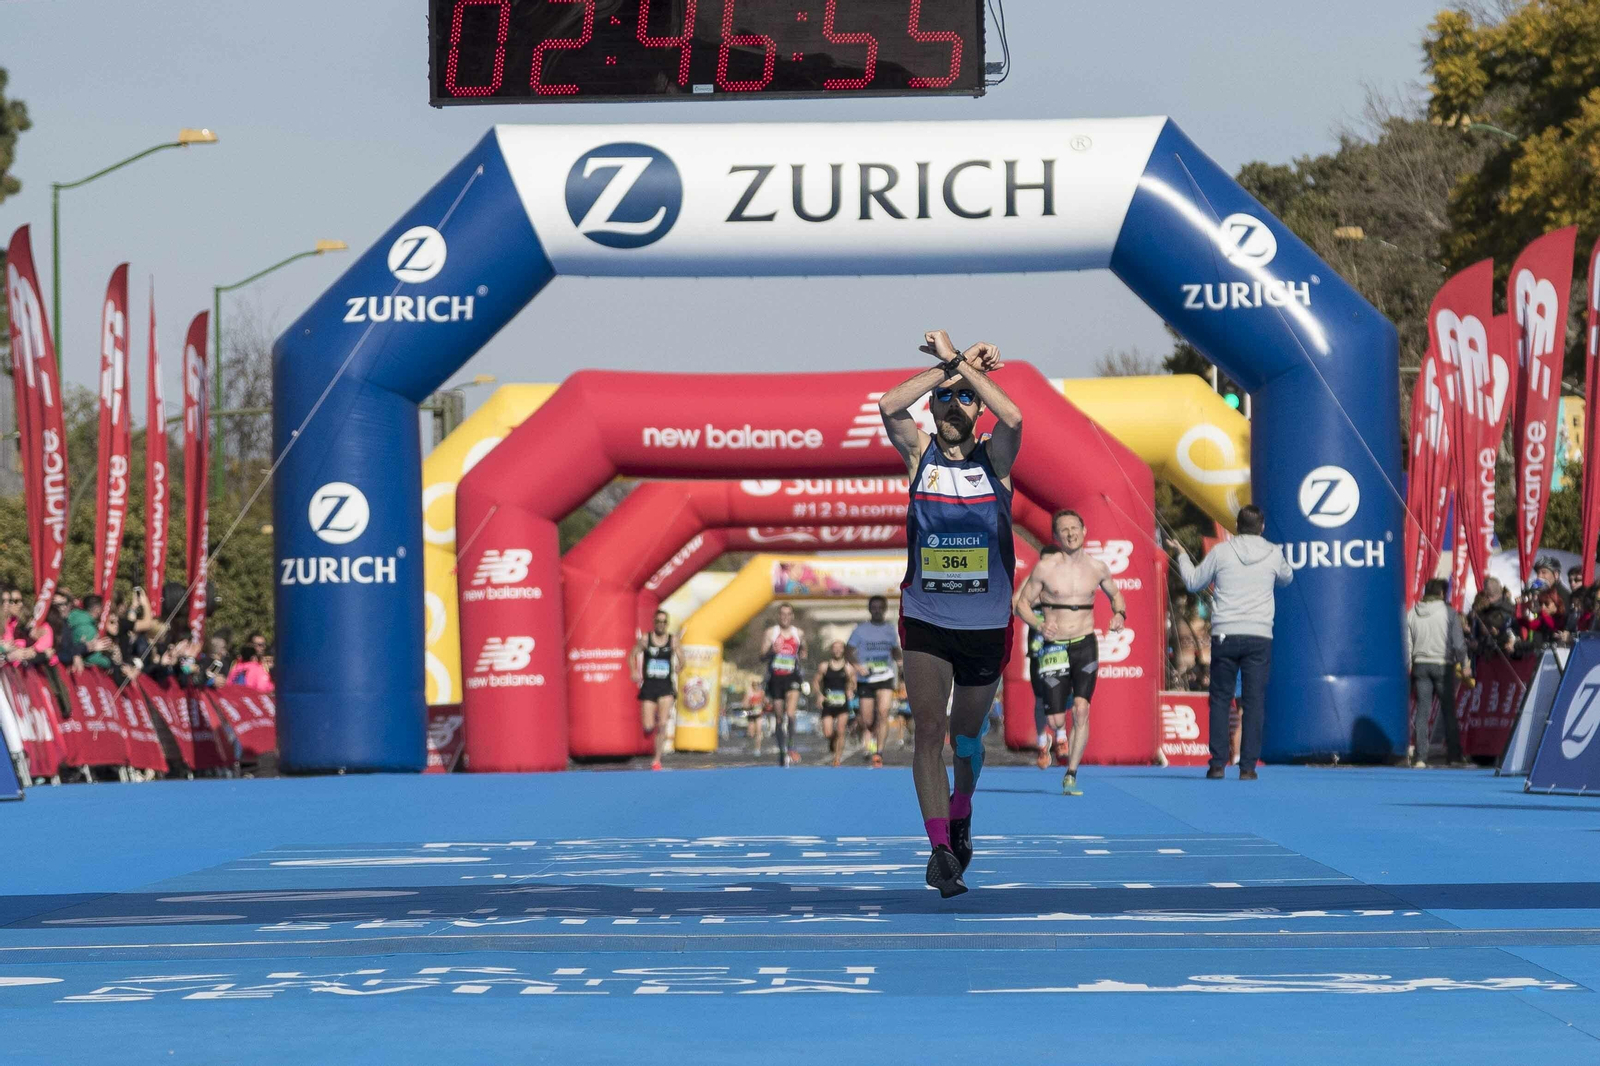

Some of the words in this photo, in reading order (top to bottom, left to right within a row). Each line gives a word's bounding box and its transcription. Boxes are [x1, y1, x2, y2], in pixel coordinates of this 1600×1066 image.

[725, 158, 1058, 224] ZURICH
[342, 294, 475, 324] ZURICH
[1181, 281, 1312, 310] ZURICH
[642, 427, 701, 448] new
[705, 424, 824, 449] balance
[941, 537, 980, 546] ZURICH
[1285, 540, 1385, 569] URICH
[280, 556, 397, 586] ZURICH
[942, 556, 968, 569] 364
[463, 588, 485, 601] new
[487, 586, 542, 600] balance
[466, 675, 489, 690] new
[490, 673, 546, 687] balance
